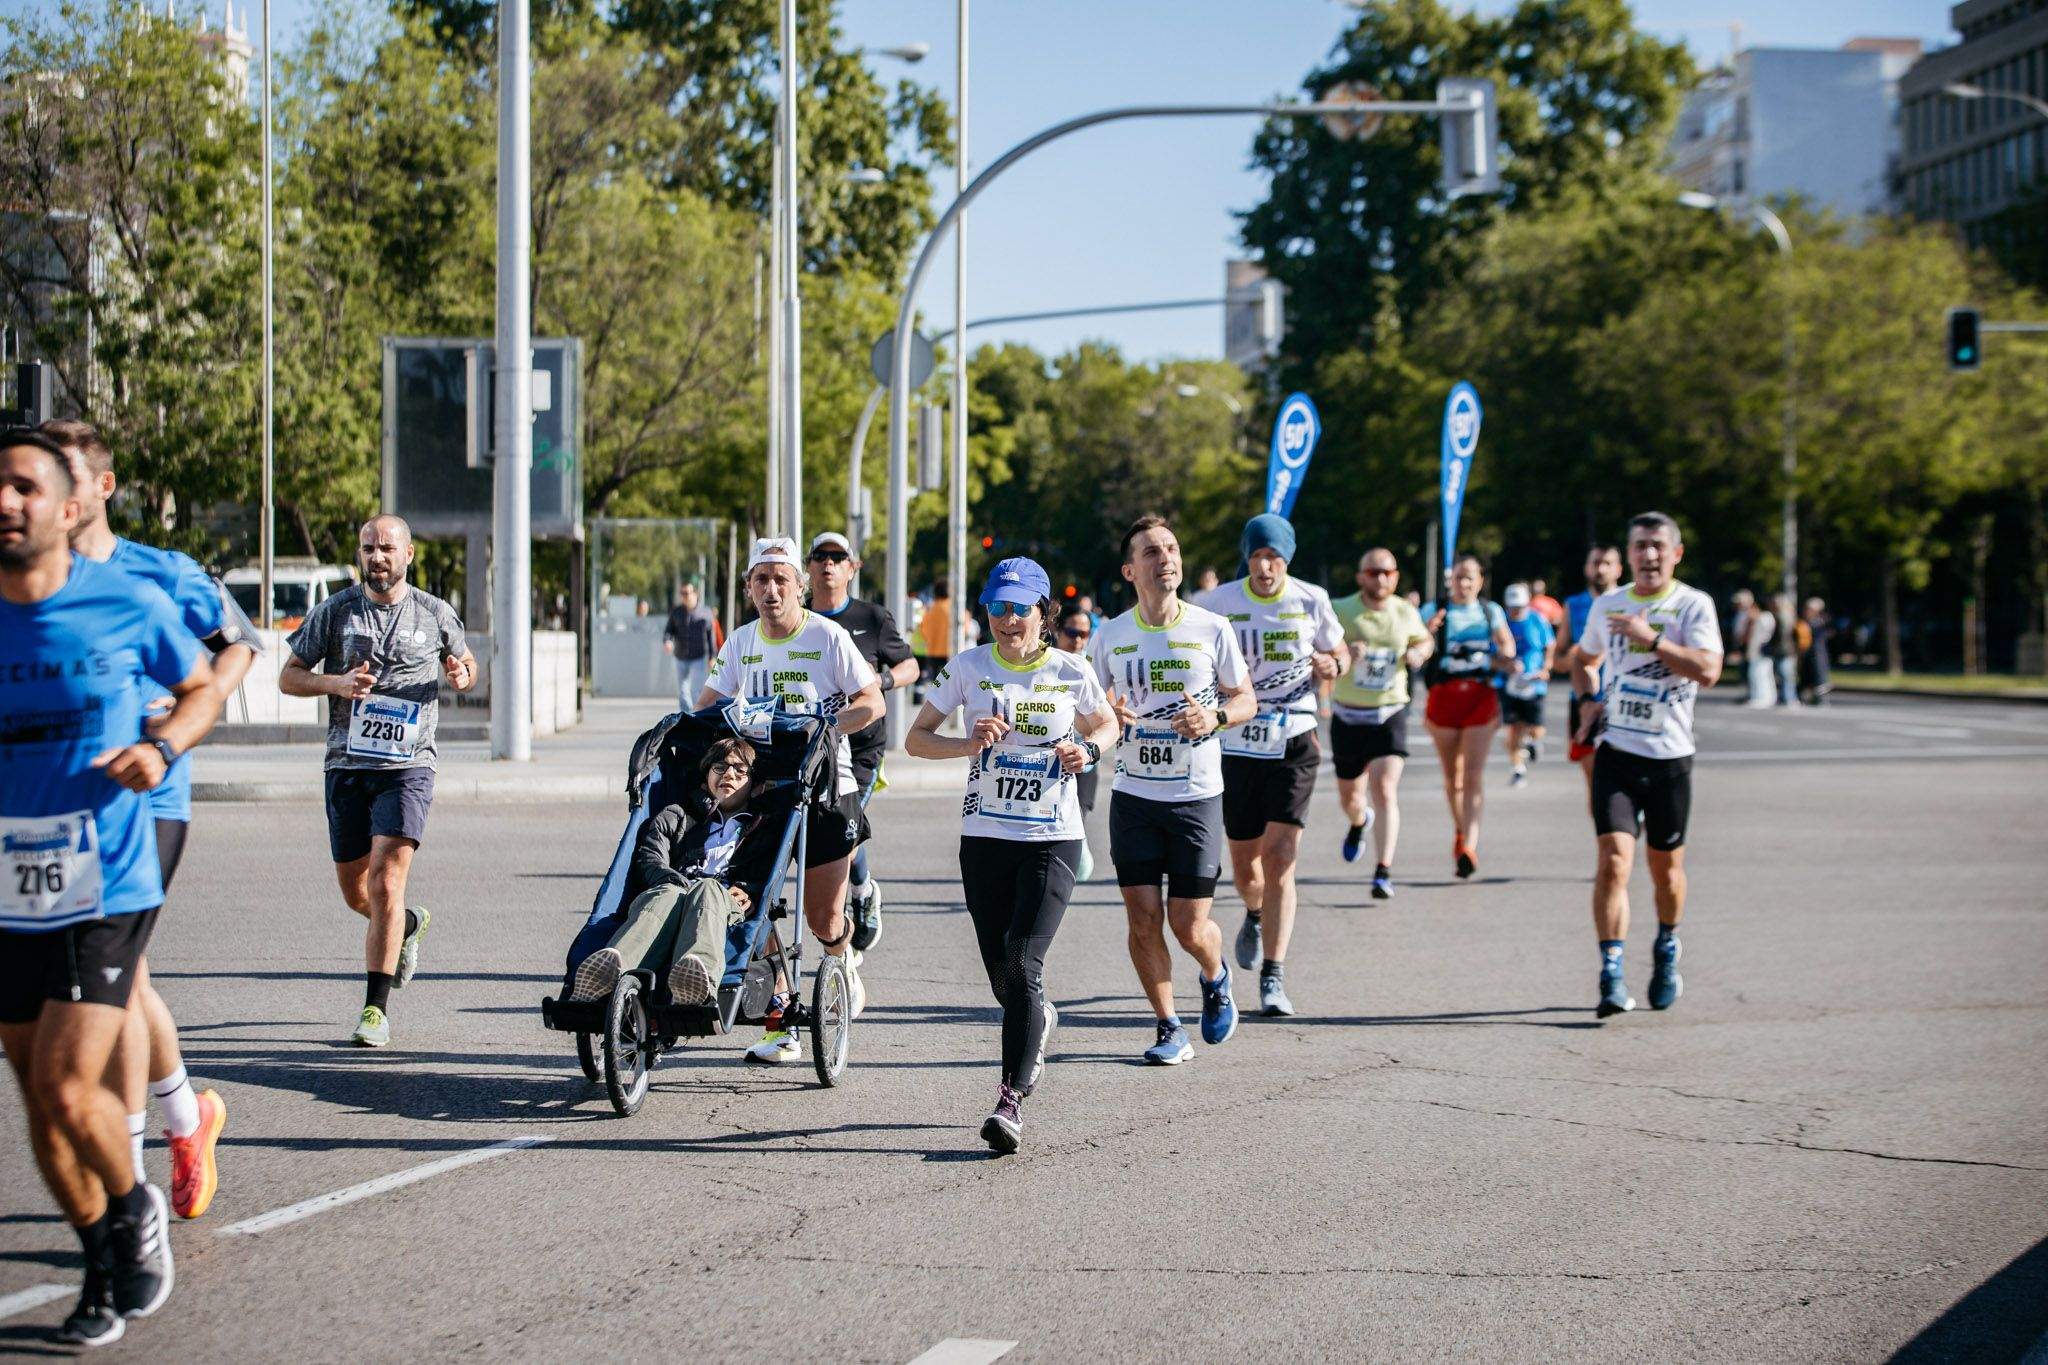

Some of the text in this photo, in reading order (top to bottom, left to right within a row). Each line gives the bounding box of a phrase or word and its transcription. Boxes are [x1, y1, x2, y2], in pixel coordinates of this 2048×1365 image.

[1264, 631, 1299, 640] CARROS
[1264, 642, 1276, 651] DE
[1150, 660, 1191, 670] CARROS
[773, 672, 808, 682] CARROS
[1150, 671, 1164, 681] DE
[773, 683, 785, 693] DE
[1151, 682, 1185, 692] FUEGO
[1016, 702, 1056, 713] CARROS
[369, 713, 406, 724] DECIMAS
[1015, 713, 1029, 723] DE
[361, 719, 405, 742] 2230
[1015, 724, 1048, 736] FUEGO
[1241, 725, 1269, 742] 431
[1006, 755, 1047, 765] BOMBEROS
[1139, 745, 1174, 765] 684
[1000, 768, 1044, 778] DECIMAS
[995, 776, 1042, 802] 1723
[16, 863, 64, 895] 276
